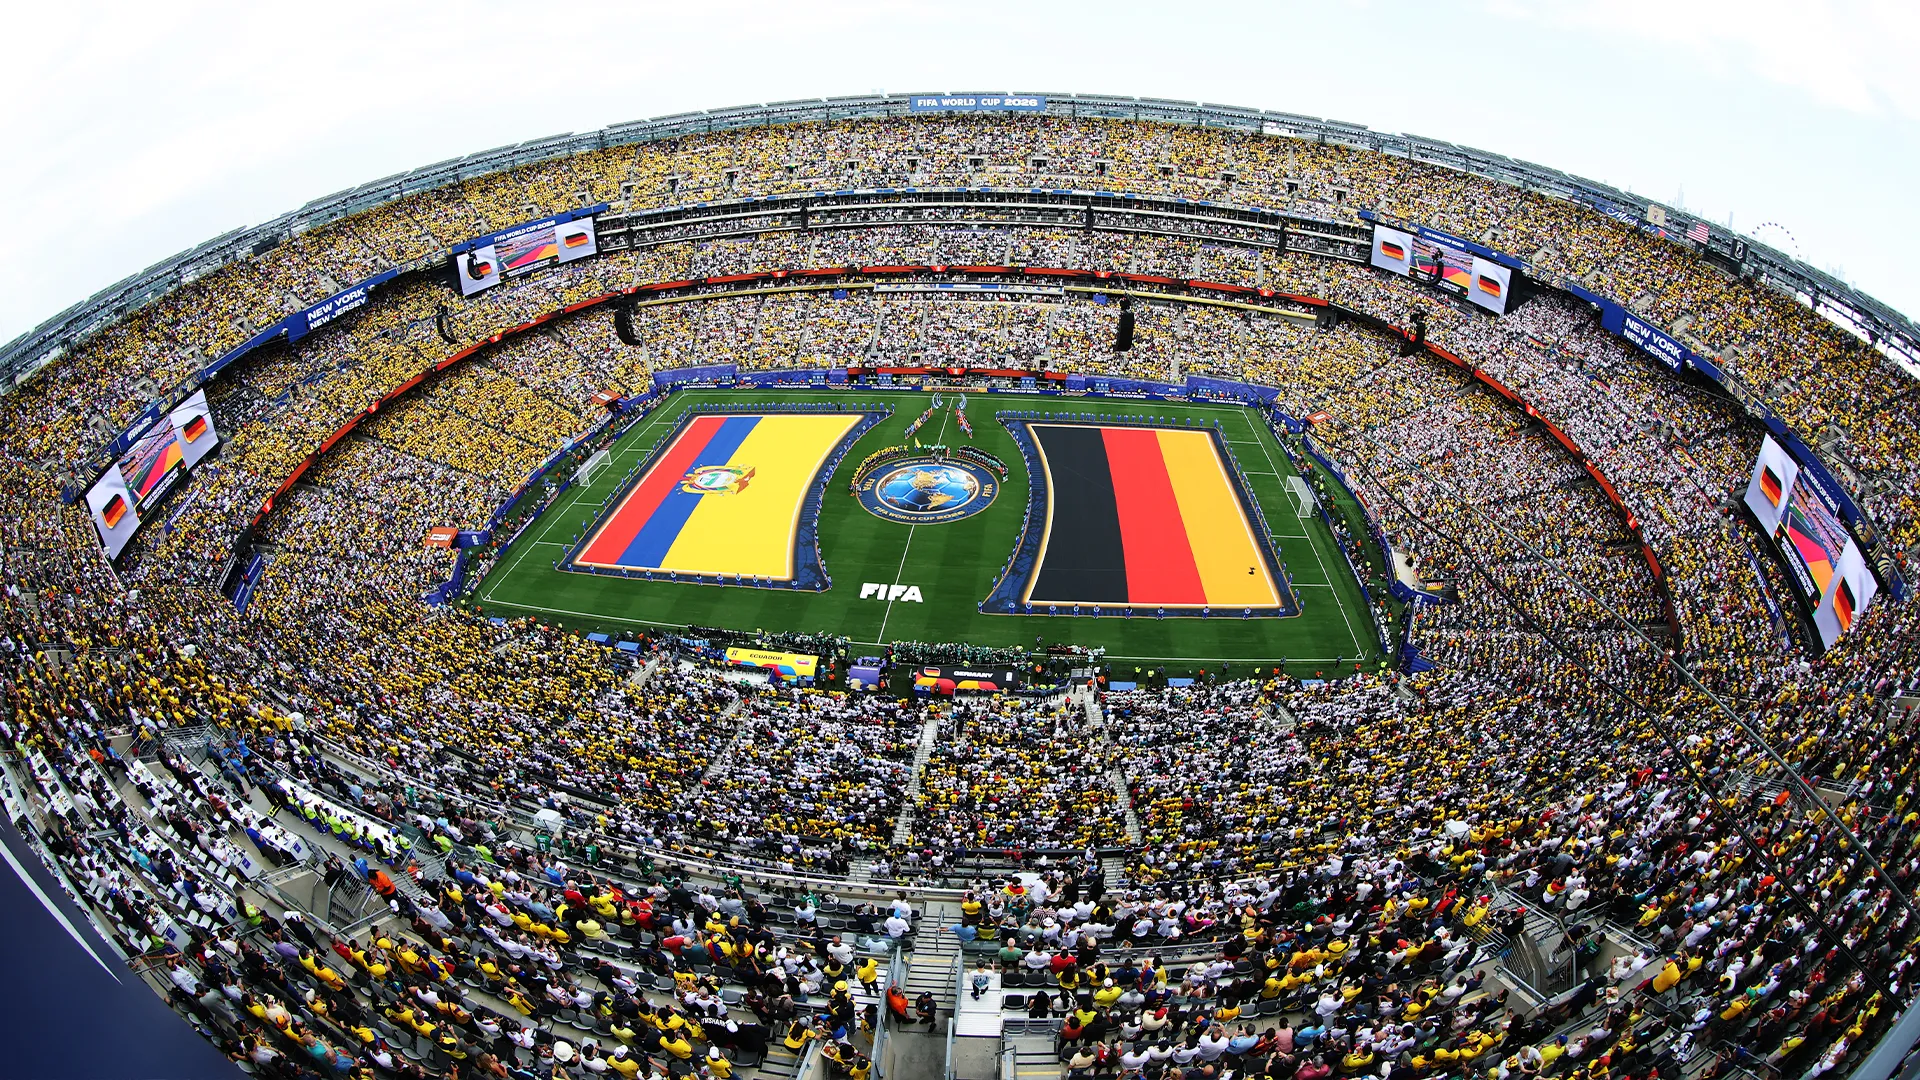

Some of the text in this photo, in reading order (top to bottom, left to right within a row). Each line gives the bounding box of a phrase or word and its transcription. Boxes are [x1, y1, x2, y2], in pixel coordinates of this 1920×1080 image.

[917, 98, 1038, 107] FIFA WORLD CUP 2026
[494, 233, 506, 242] FIFA
[506, 228, 526, 238] WORLD
[307, 287, 366, 321] NEW YORK
[309, 297, 366, 330] NEW JERSEY
[1625, 317, 1682, 360] NEW YORK
[1623, 329, 1680, 369] NEW JERSEY
[982, 483, 993, 497] FIFA
[874, 506, 888, 515] FIFA
[889, 512, 917, 521] WORLD
[937, 510, 965, 520] 2026
[860, 582, 924, 603] FIFA
[749, 653, 783, 661] ECUADOR
[953, 670, 993, 679] GERMANY
